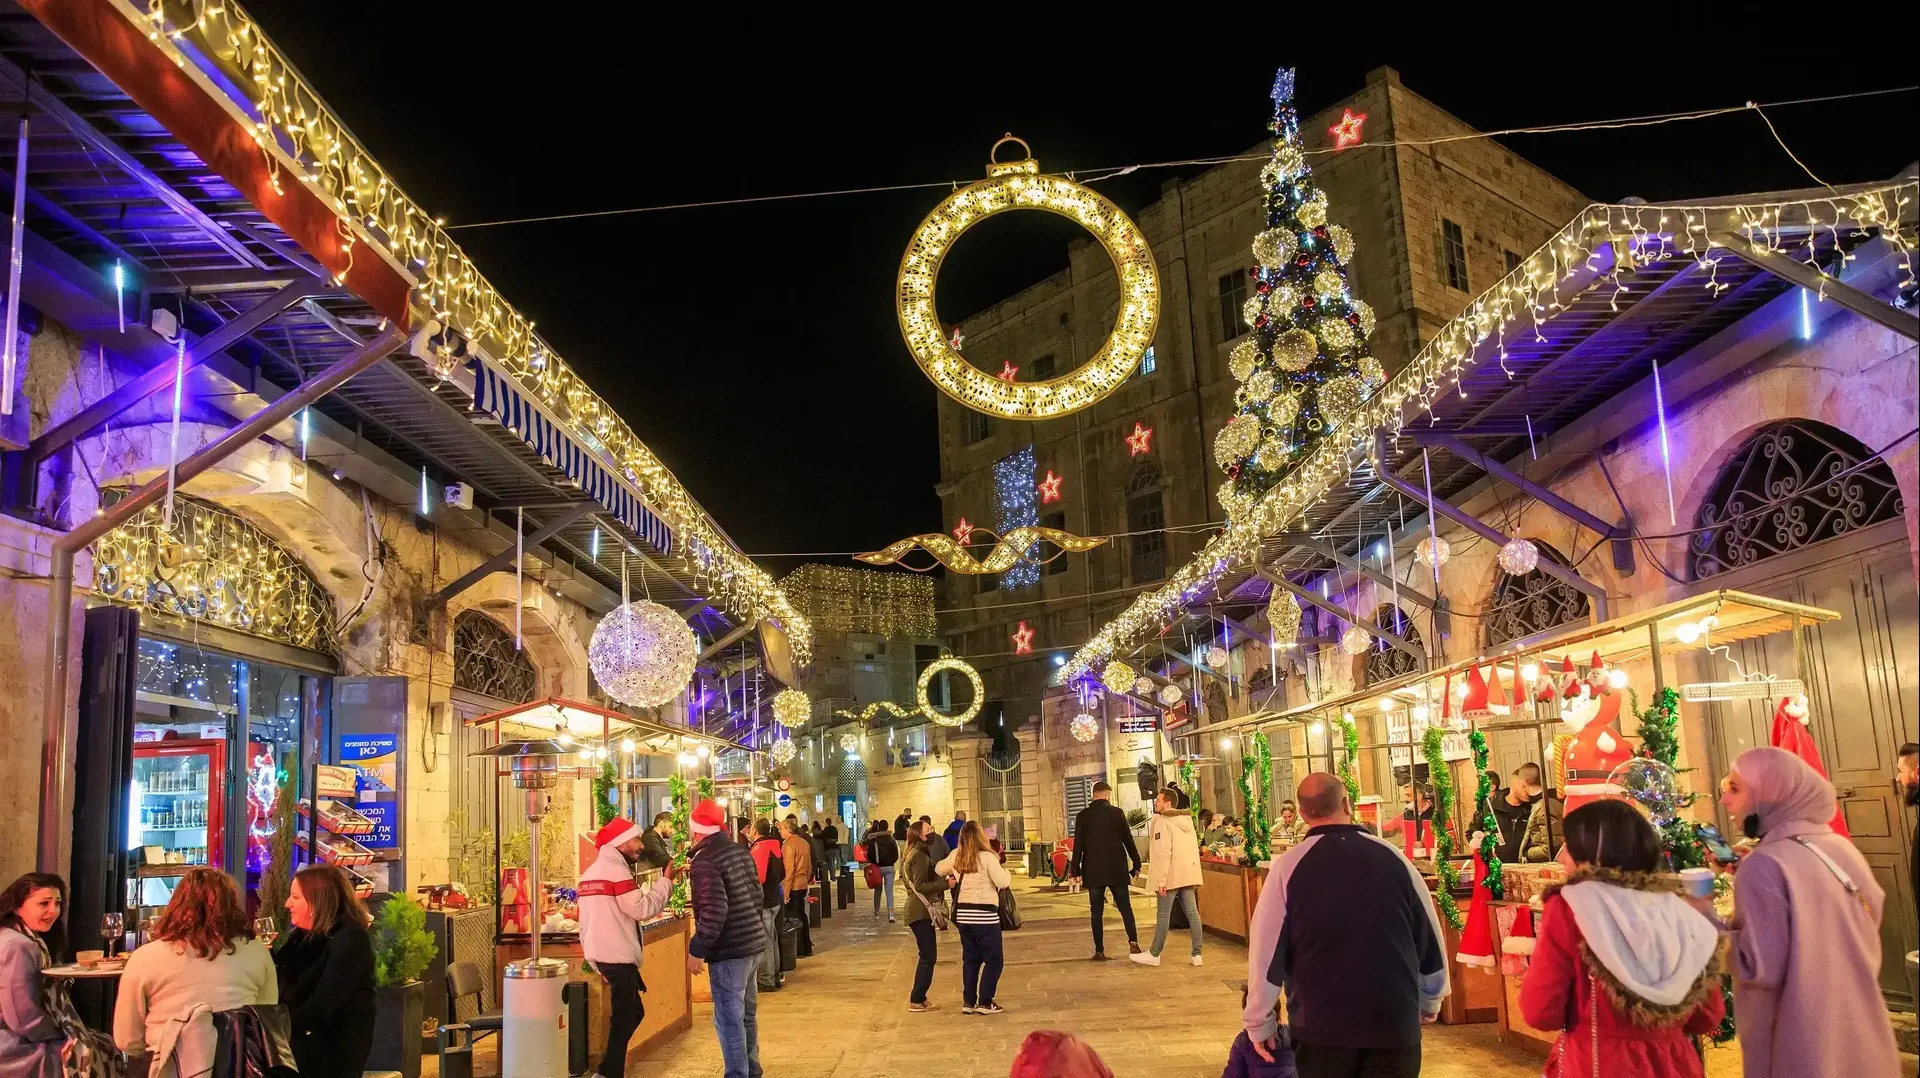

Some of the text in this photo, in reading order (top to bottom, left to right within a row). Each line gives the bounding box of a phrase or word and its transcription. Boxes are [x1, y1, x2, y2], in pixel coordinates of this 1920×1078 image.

[360, 746, 377, 756] כאן
[356, 768, 384, 778] ATM
[380, 832, 390, 841] כל
